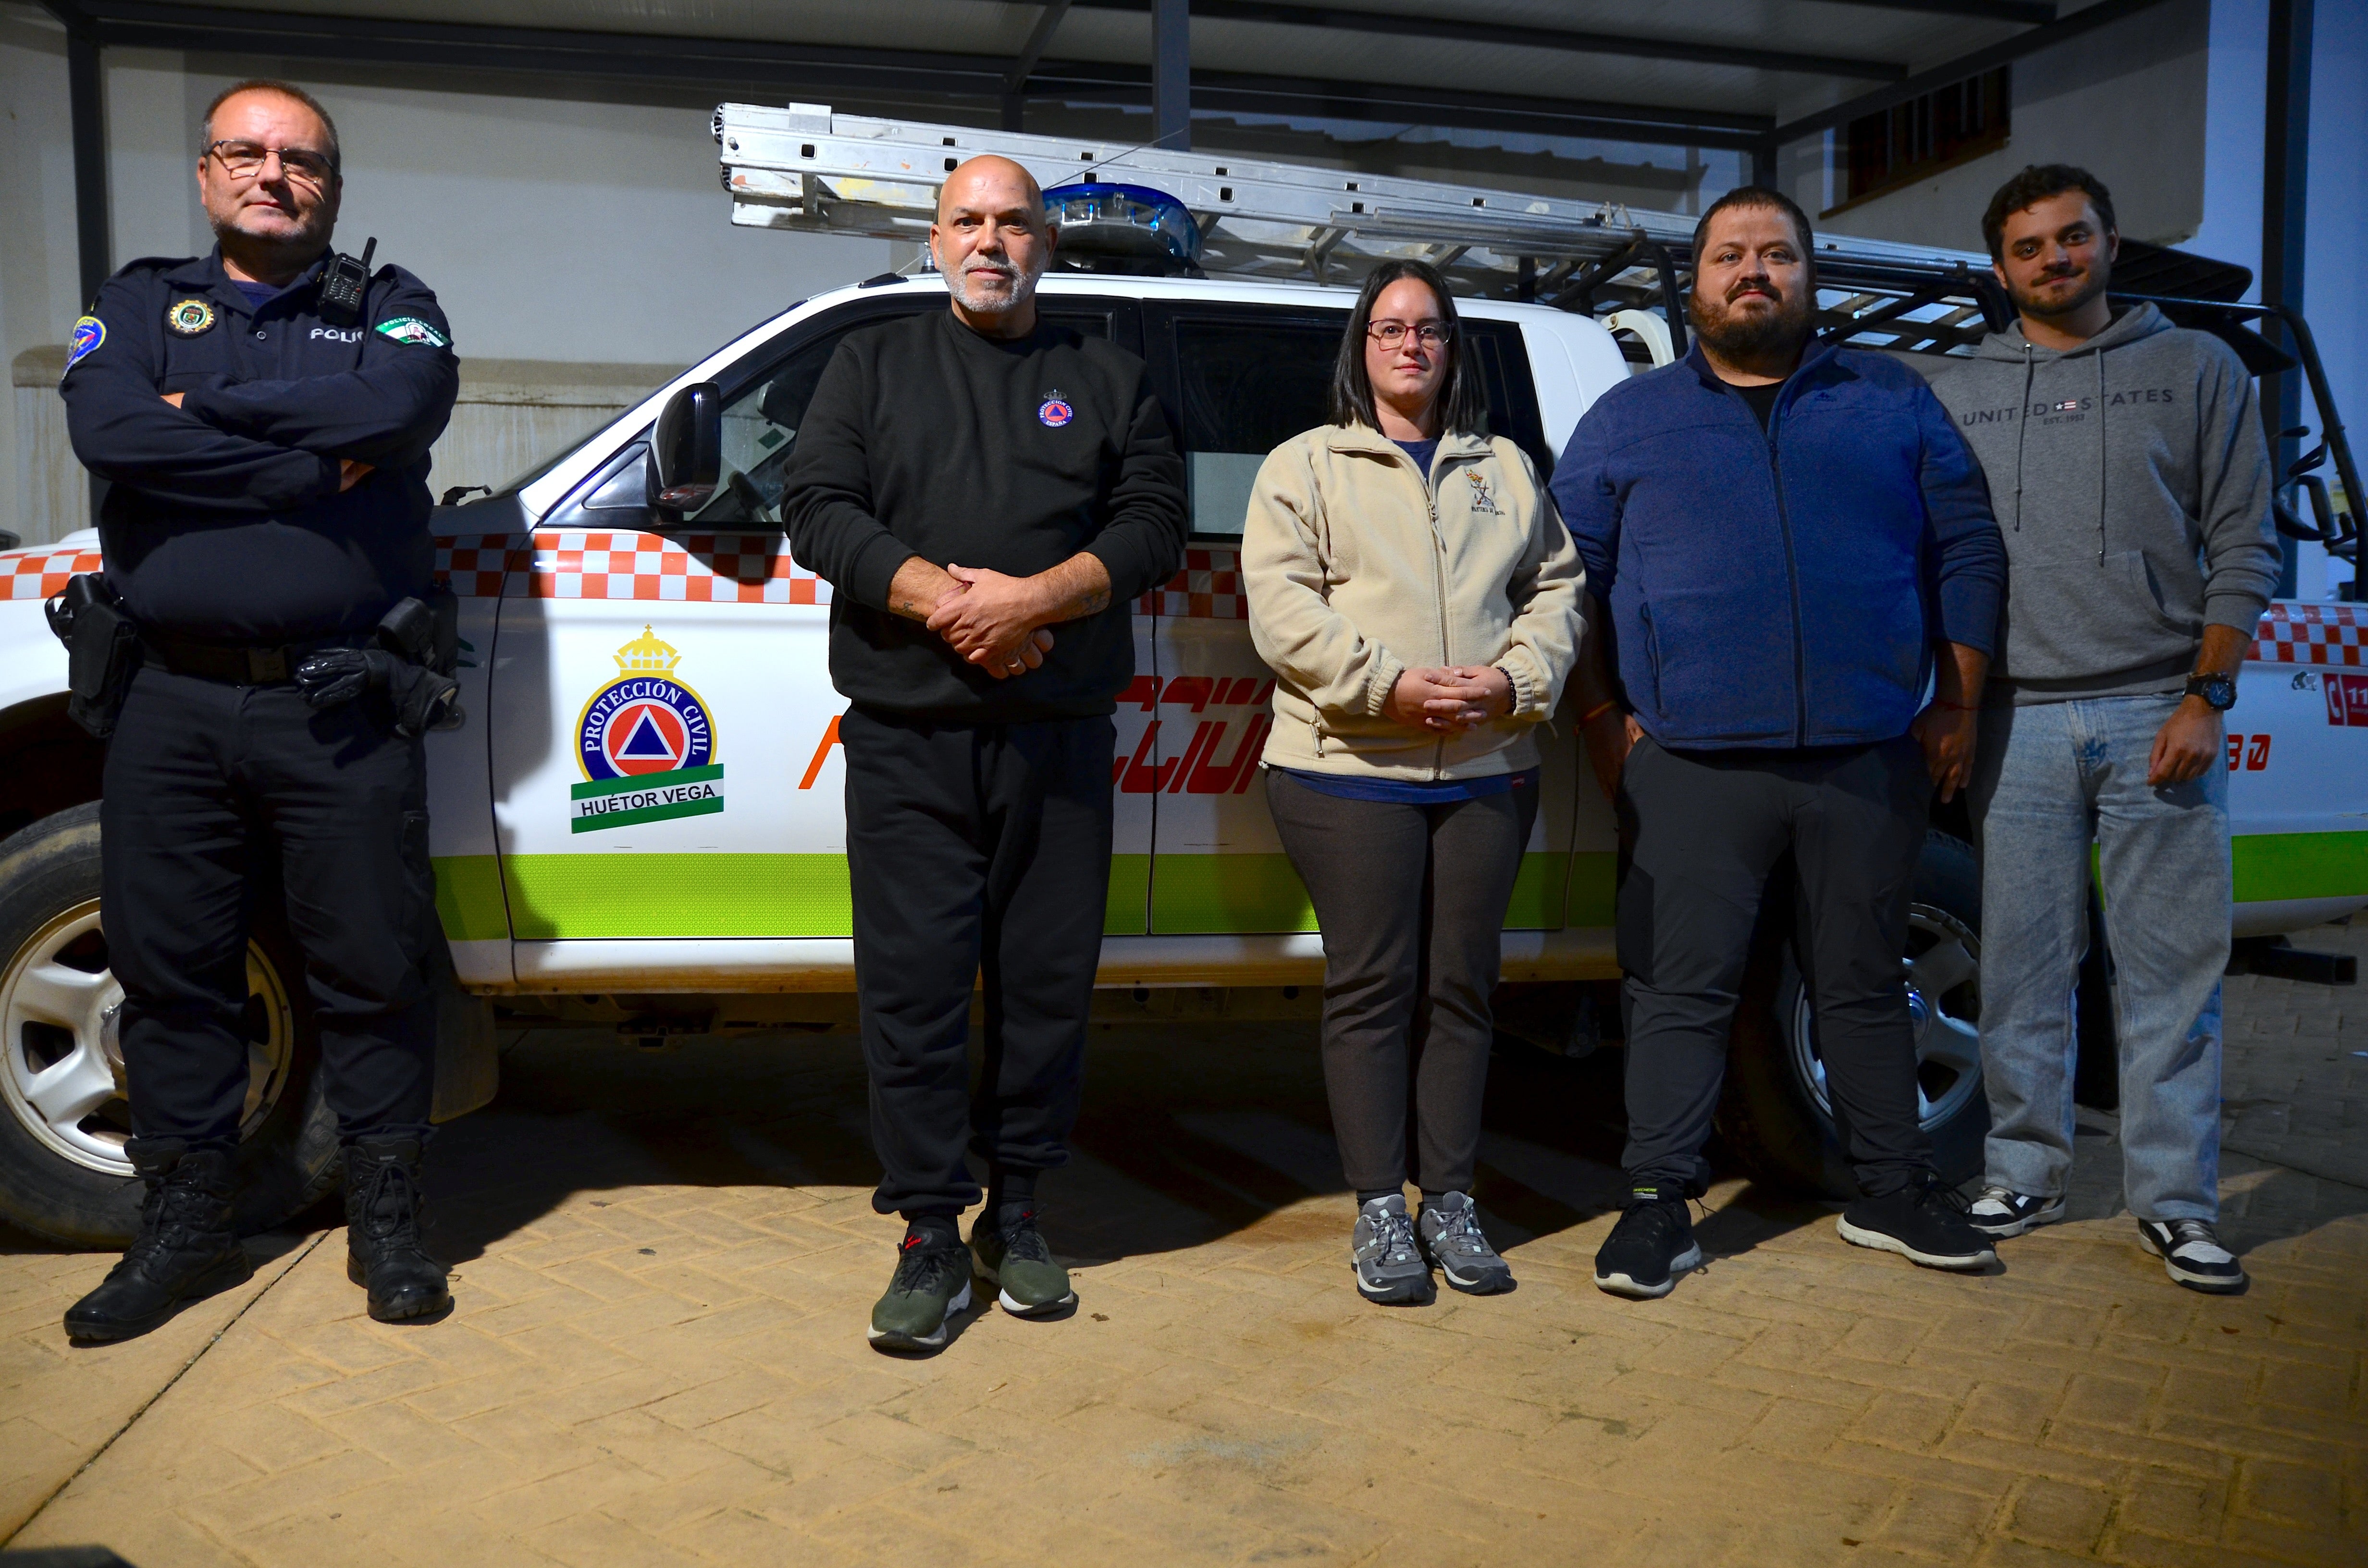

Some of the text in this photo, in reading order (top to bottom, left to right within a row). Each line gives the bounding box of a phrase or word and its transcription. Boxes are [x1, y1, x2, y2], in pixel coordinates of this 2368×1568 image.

[419, 320, 442, 338] LOCAL
[2043, 416, 2063, 426] EST.
[585, 679, 708, 755] PROTECCIÓN CIVIL
[581, 784, 715, 816] HUÉTOR VEGA
